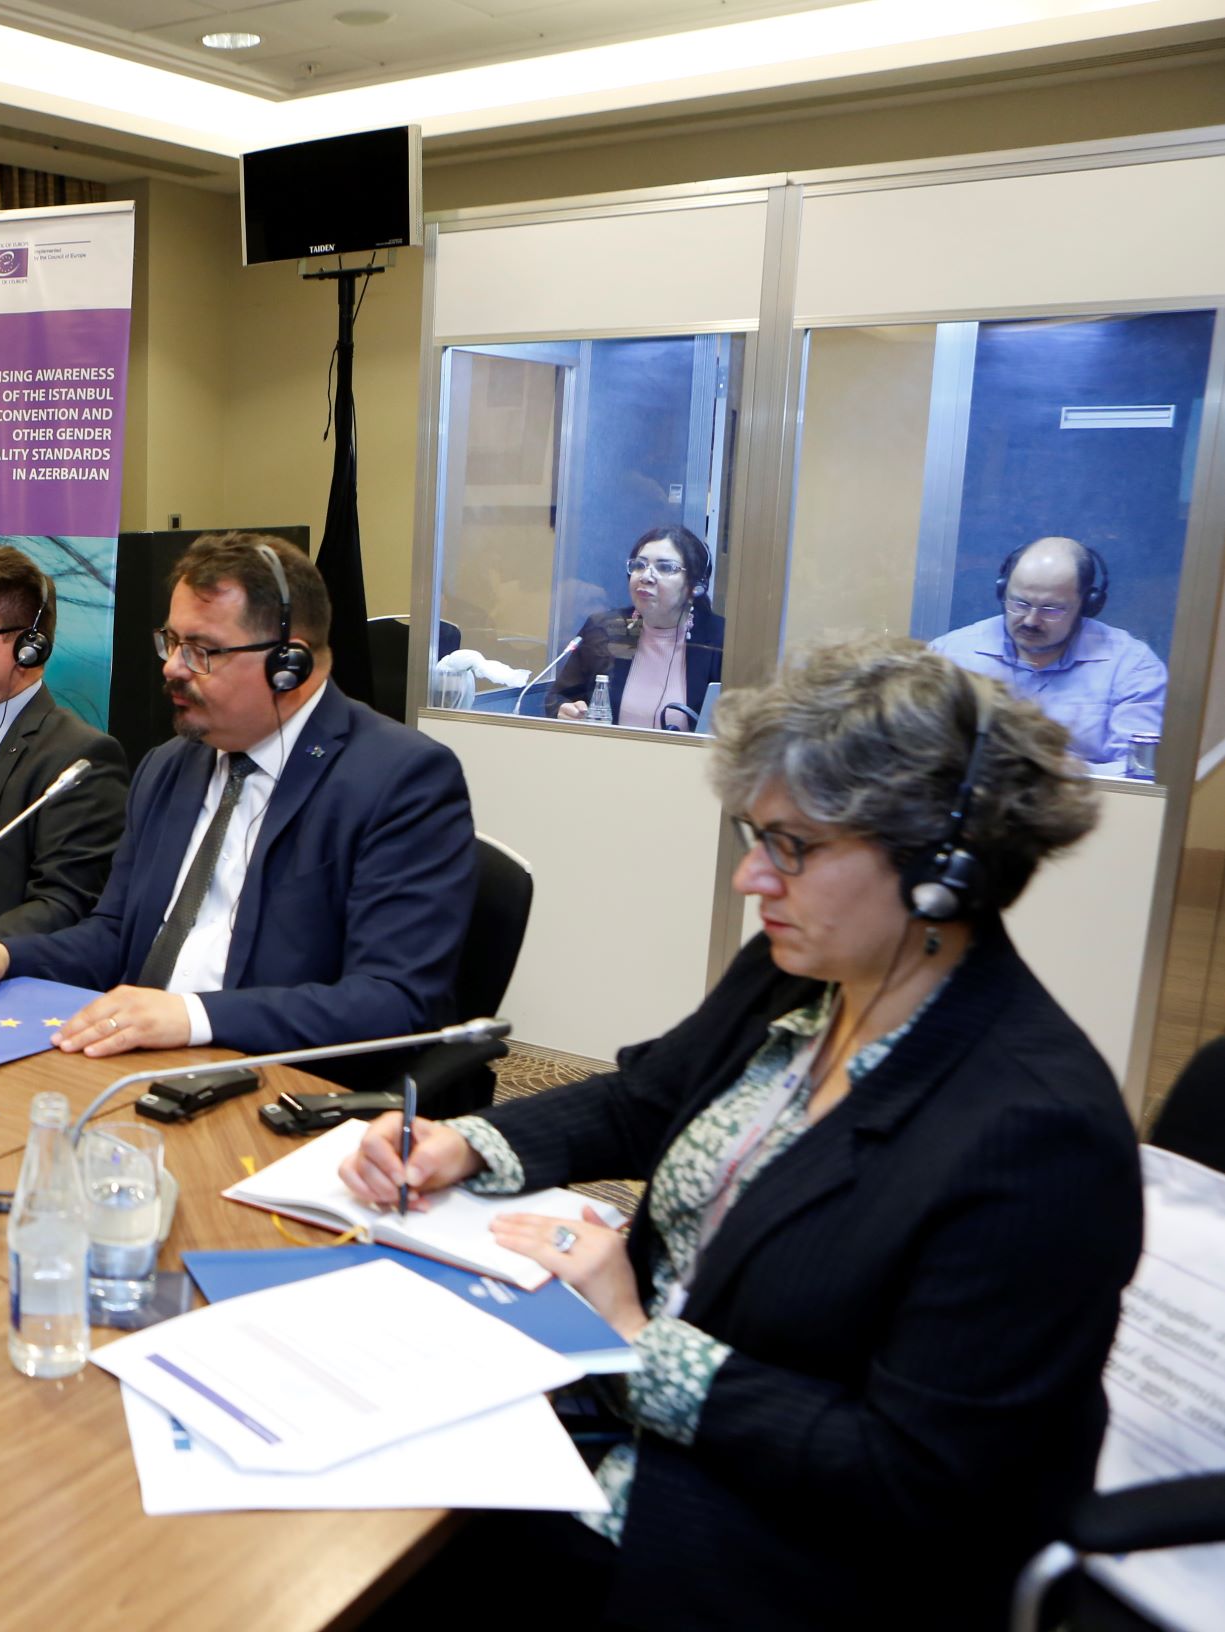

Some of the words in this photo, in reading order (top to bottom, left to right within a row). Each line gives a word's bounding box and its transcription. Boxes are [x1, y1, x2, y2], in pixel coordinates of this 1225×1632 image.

[309, 243, 335, 254] TAIDEN
[35, 368, 115, 382] AWARENESS
[2, 390, 21, 402] OF
[22, 389, 46, 402] THE
[48, 388, 114, 401] ISTANBUL
[81, 408, 113, 420] AND
[12, 428, 53, 441] OTHER
[56, 428, 112, 441] GENDER
[31, 448, 111, 461] STANDARDS
[12, 468, 26, 480] IN
[29, 468, 110, 481] AZERBAIJAN
